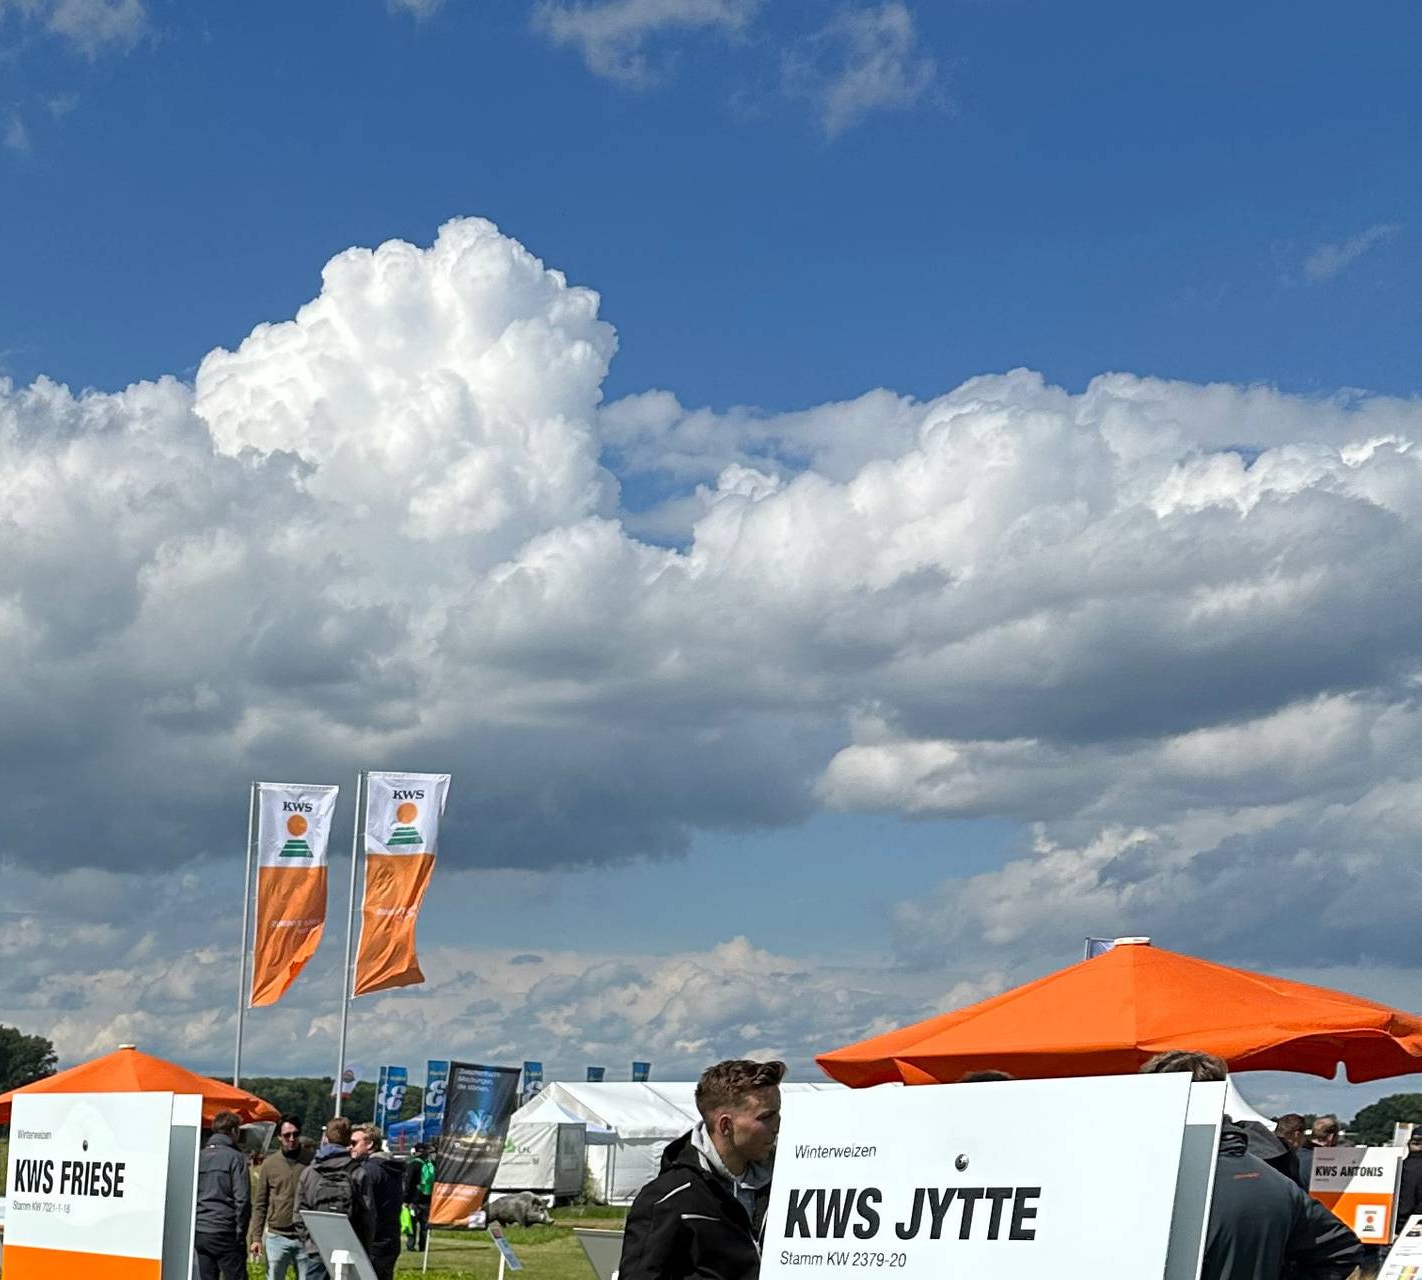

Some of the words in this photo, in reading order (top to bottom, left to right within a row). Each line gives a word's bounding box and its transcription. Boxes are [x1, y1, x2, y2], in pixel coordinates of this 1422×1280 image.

[392, 789, 425, 800] KWS
[282, 801, 313, 813] KWS
[17, 1129, 52, 1140] Winterweizen
[795, 1143, 877, 1159] Winterweizen
[1315, 1165, 1337, 1177] KWS
[1340, 1166, 1384, 1177] ANTONIS
[14, 1159, 54, 1194] KWS
[60, 1160, 126, 1198] FRIESE
[13, 1200, 31, 1210] Stamm
[32, 1201, 41, 1211] KW
[784, 1187, 882, 1240] KWS
[895, 1187, 1041, 1240] JYTTE
[780, 1250, 823, 1266] Stamm
[827, 1251, 849, 1266] KW
[852, 1252, 907, 1268] 2379-20
